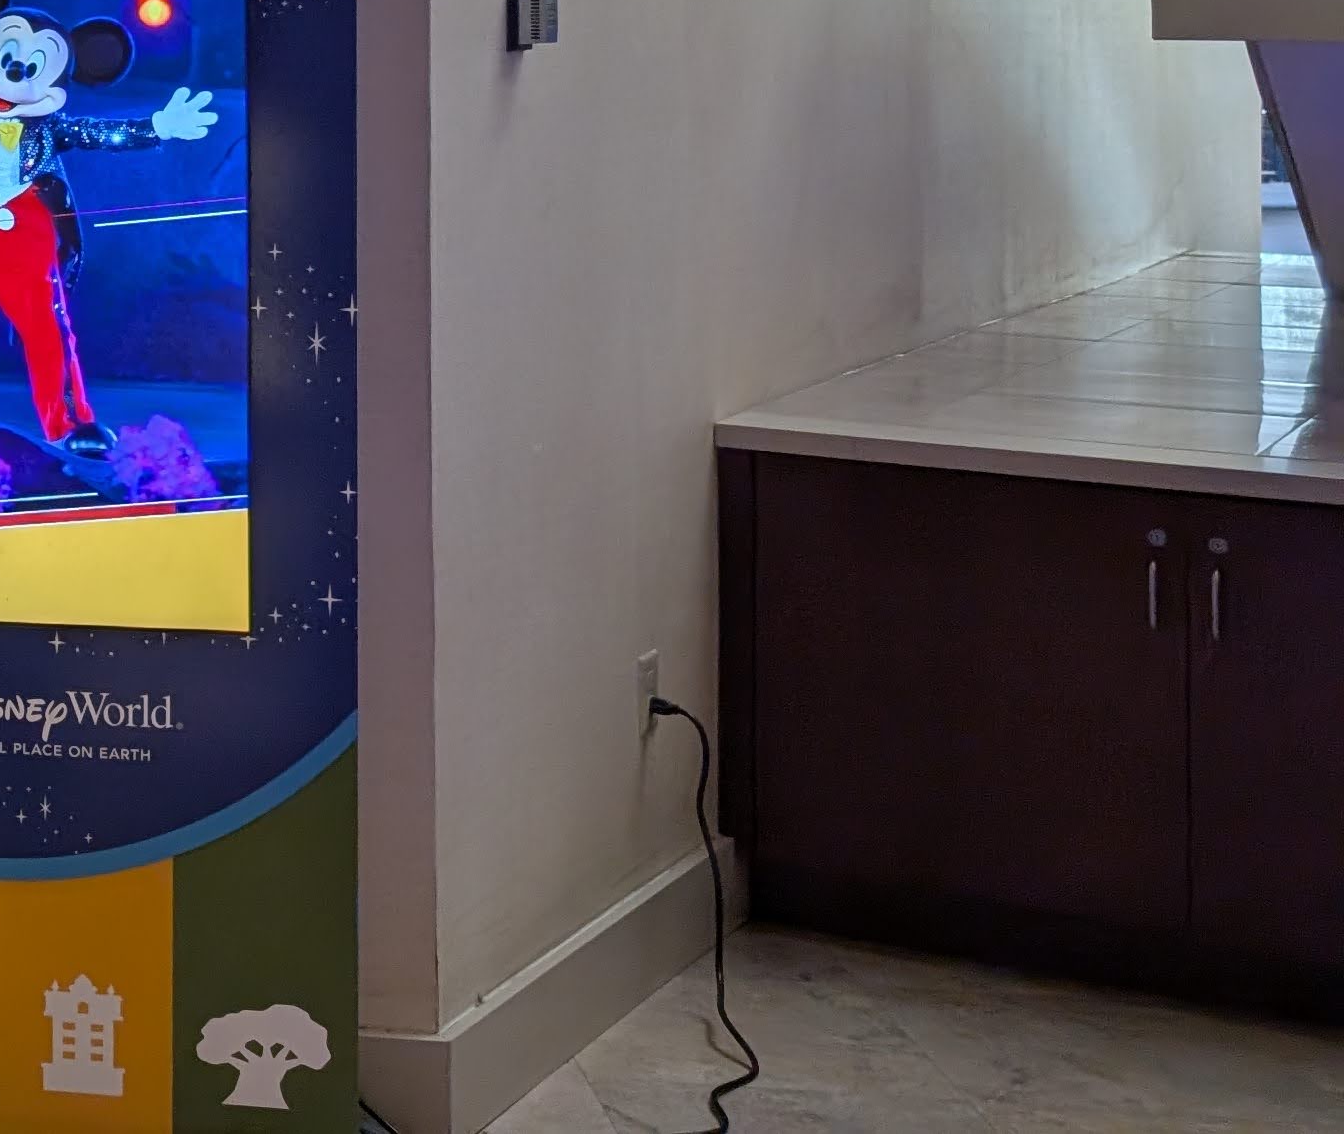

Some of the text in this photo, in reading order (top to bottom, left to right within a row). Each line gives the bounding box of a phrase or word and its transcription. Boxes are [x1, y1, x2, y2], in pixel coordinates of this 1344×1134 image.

[13, 742, 62, 757] PLACE
[68, 745, 93, 759] ON
[99, 747, 151, 762] EARTH
